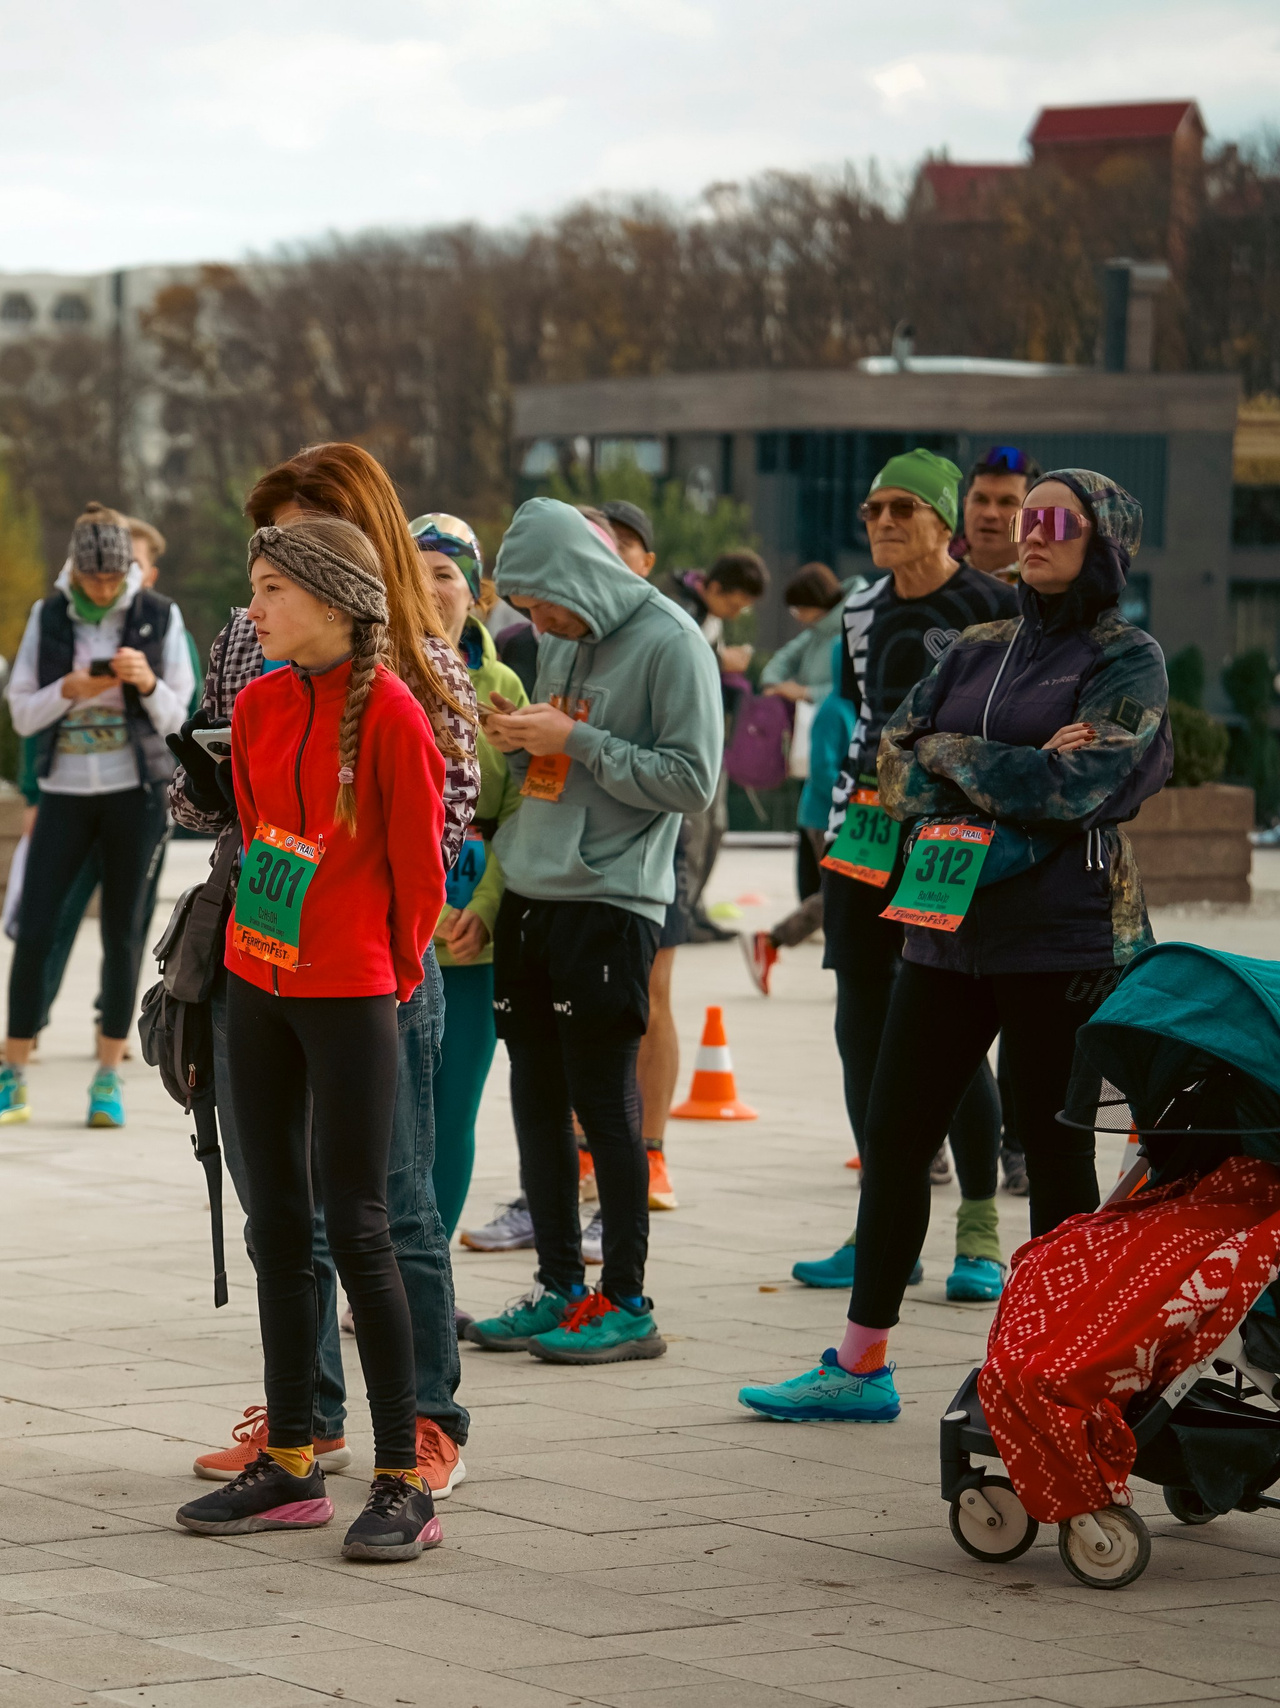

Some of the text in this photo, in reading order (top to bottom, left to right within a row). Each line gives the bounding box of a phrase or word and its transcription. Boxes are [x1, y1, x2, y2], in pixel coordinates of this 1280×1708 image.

[849, 809, 893, 845] 313
[249, 851, 306, 909] 301
[453, 848, 477, 882] 14
[915, 845, 974, 885] 312
